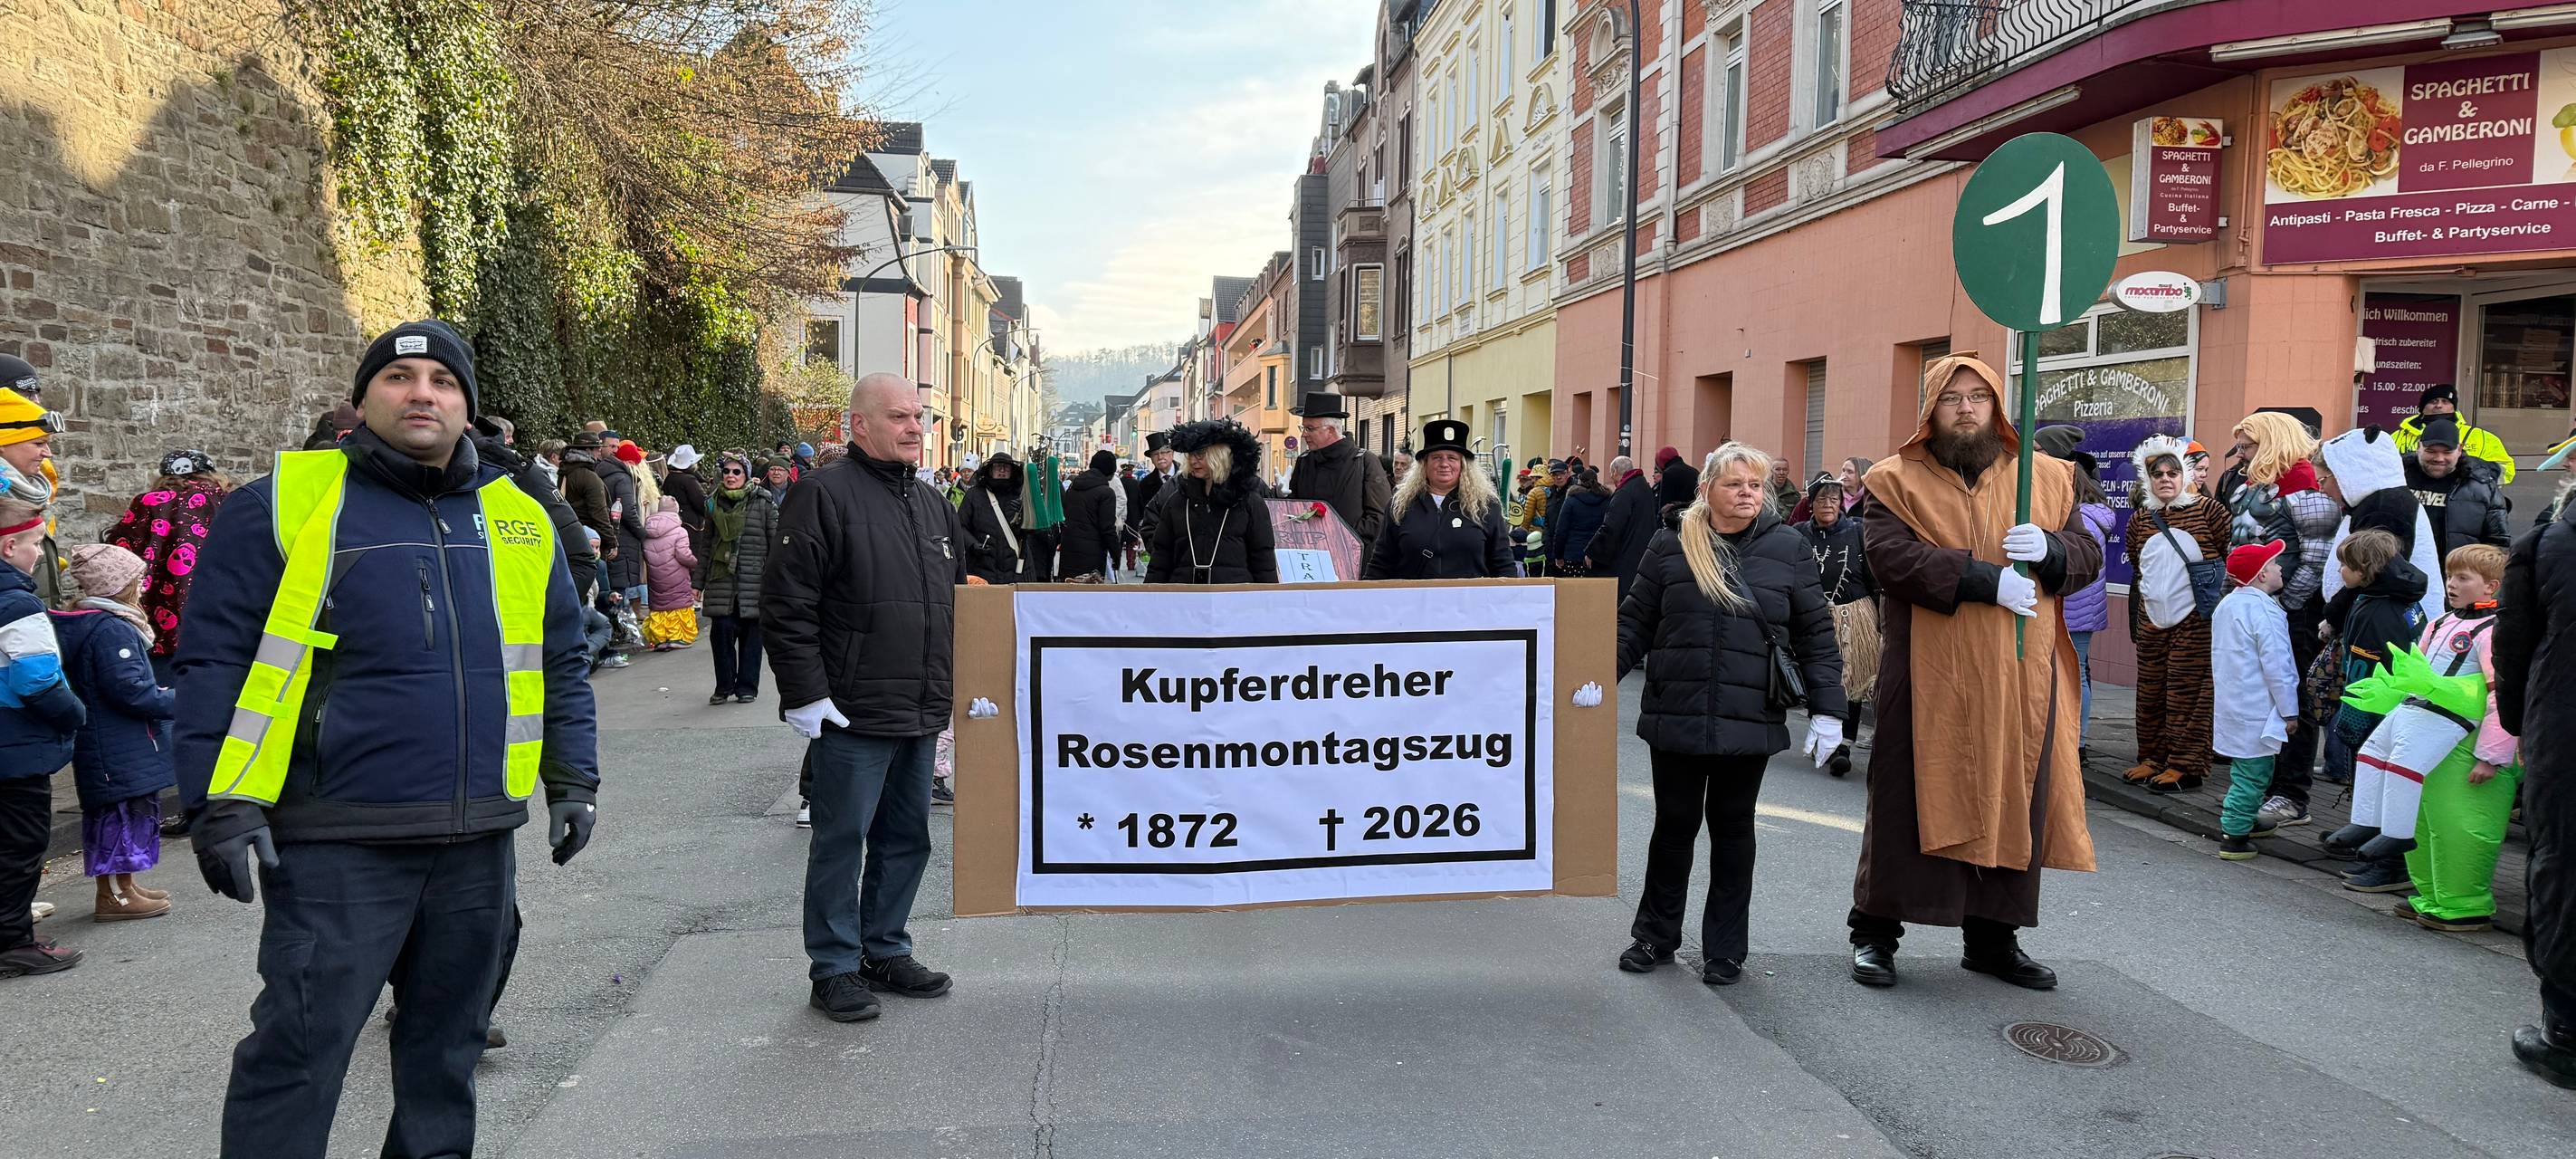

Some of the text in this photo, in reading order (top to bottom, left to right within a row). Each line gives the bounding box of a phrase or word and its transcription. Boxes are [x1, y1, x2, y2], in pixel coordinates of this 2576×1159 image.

[2410, 72, 2531, 101] SPAGHETTI
[2457, 101, 2478, 118] &
[2403, 117, 2533, 145] GAMBERONI
[2161, 150, 2211, 161] SPAGHETTI
[2181, 163, 2190, 172] &
[2419, 156, 2514, 172] da F. Pellegrino
[2159, 174, 2211, 185] GAMBERONI
[2168, 203, 2200, 212] Buffet-
[2269, 211, 2331, 227] Antipasti
[2345, 207, 2386, 222] Pasta
[2390, 205, 2440, 219] Fresca
[2456, 201, 2495, 215] Pizza
[2511, 197, 2559, 211] Carne
[2180, 214, 2188, 223] &
[2153, 224, 2212, 235] Partyservice
[2374, 222, 2552, 243] Buffet- & Partyservice
[1982, 160, 2065, 325] 1
[2124, 286, 2183, 296] mocambo
[2383, 308, 2448, 322] Willkommen
[2375, 337, 2437, 347] frisch zubereitet
[2375, 360, 2422, 369] ungszeiten:
[2035, 368, 2170, 417] PAGHETTI & GAMBERONI
[2372, 382, 2396, 391] 15.00
[2401, 382, 2426, 392] 22.00
[2074, 398, 2113, 417] Pizzeria
[492, 519, 541, 538] RGE
[501, 536, 541, 548] SECURITY
[1121, 663, 1454, 713] Kupferdreher
[1057, 730, 1513, 771] Rosenmontagszug
[1117, 812, 1239, 848] 1872
[1362, 803, 1481, 841] 2026
